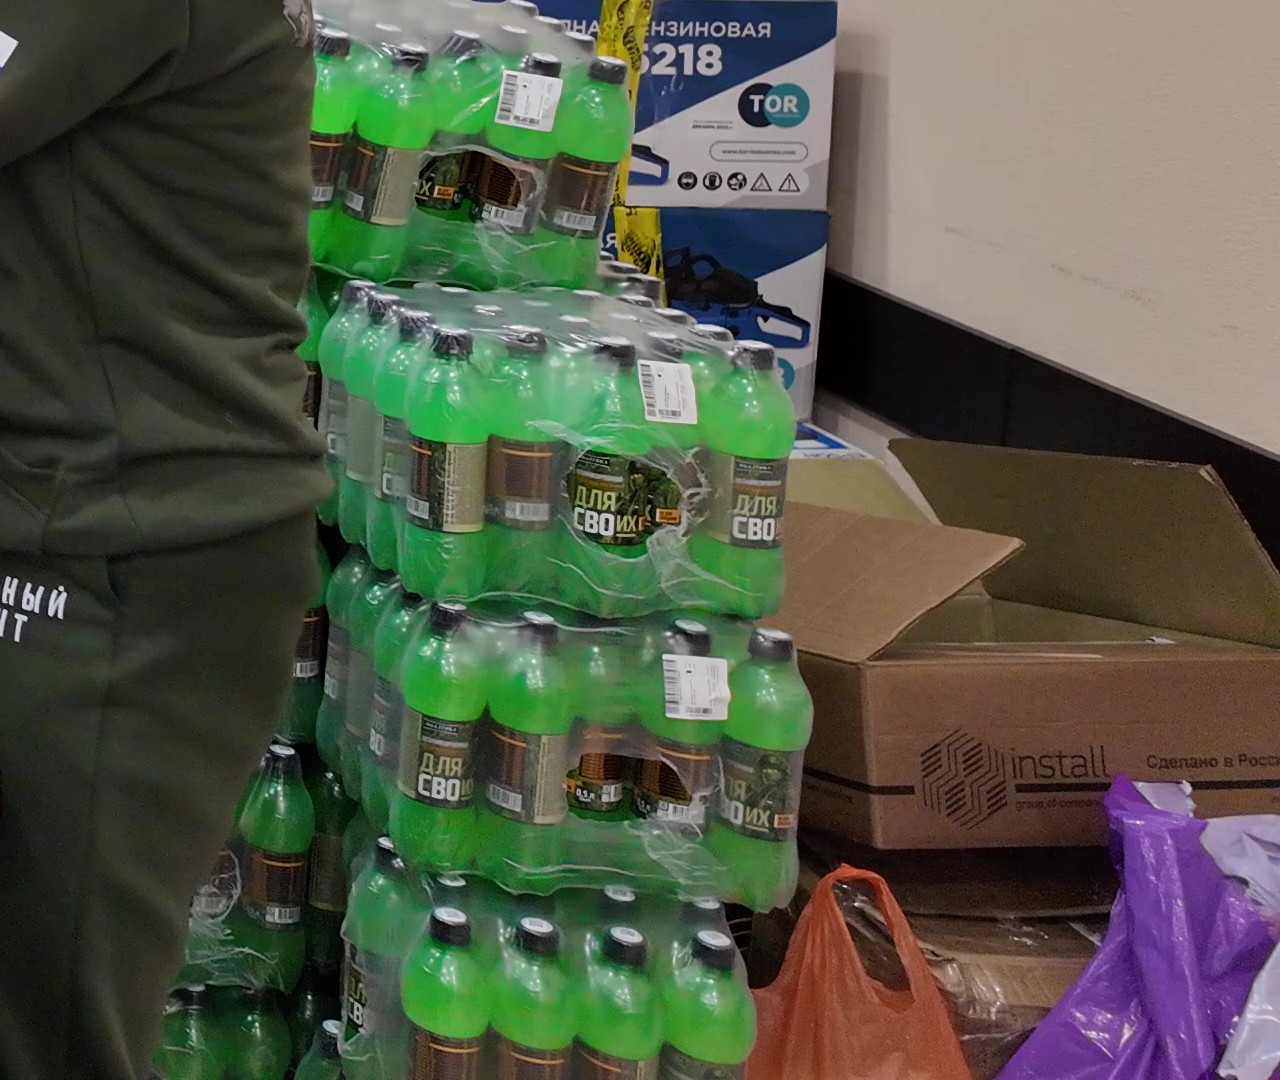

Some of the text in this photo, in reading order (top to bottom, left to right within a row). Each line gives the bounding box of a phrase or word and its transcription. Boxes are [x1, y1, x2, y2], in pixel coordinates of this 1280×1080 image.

[645, 21, 772, 39] НЗИНОВАЯ
[749, 94, 799, 113] TOR
[575, 486, 617, 512] ДЛЯ
[733, 494, 777, 516] ДЛЯ
[573, 506, 636, 537] СВОИХ
[732, 516, 778, 541] СВО
[419, 752, 463, 777] ДЛЯ
[1010, 745, 1110, 780] install
[1146, 754, 1219, 770] Сделано
[1224, 757, 1233, 768] в
